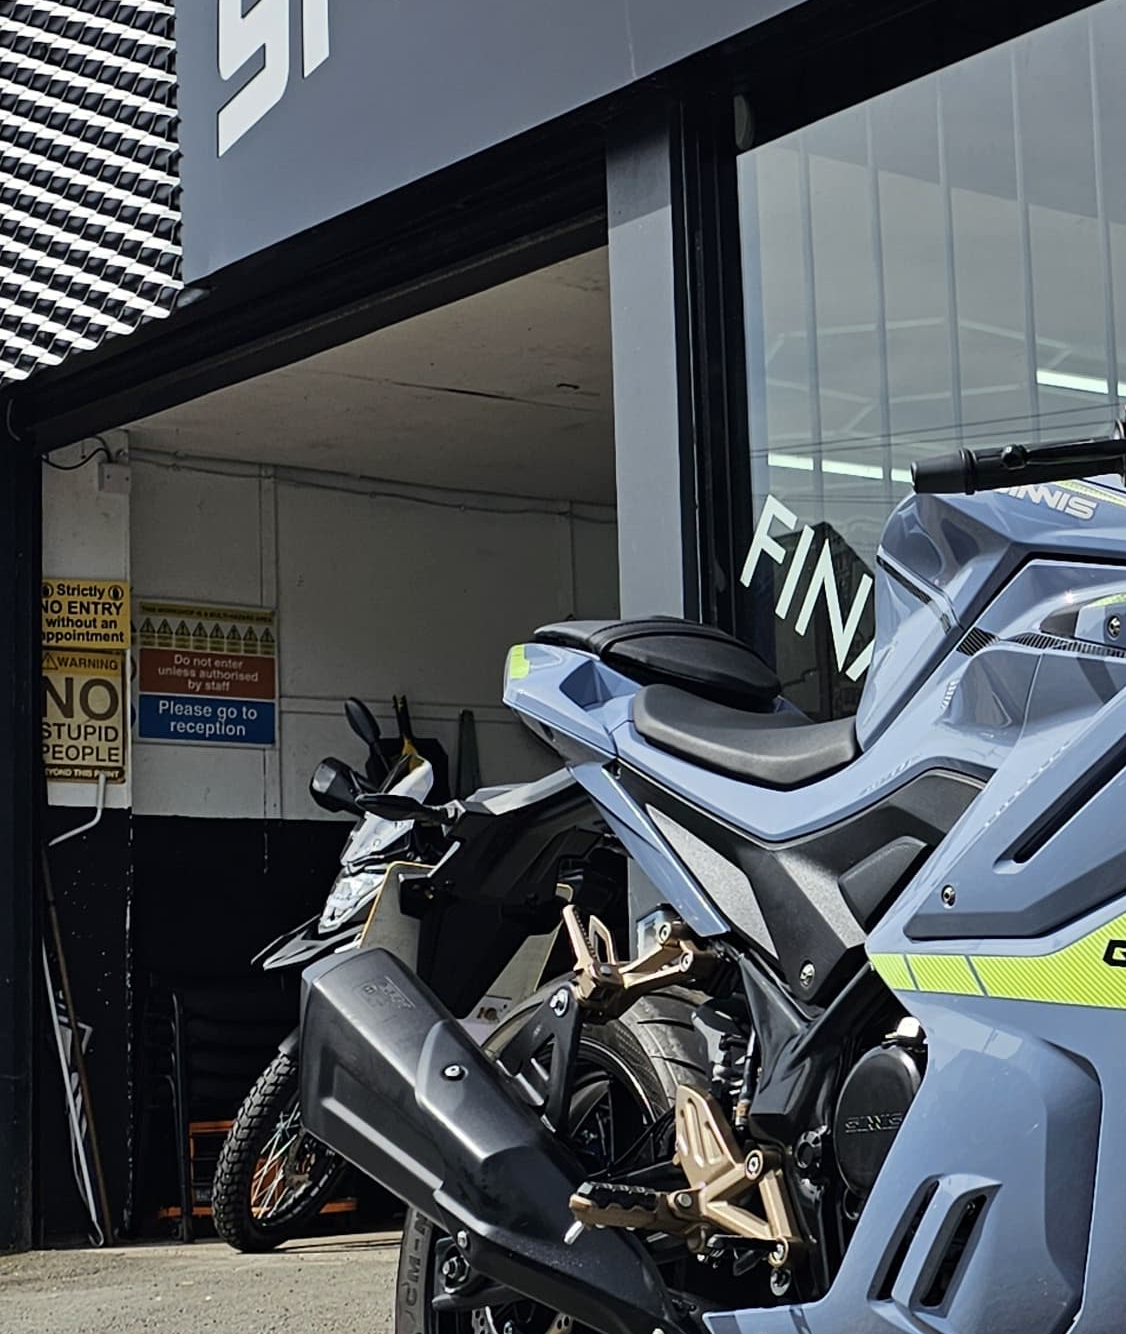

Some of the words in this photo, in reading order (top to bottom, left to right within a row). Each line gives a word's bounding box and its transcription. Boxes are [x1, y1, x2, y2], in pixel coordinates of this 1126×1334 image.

[992, 485, 1097, 520] INNIS
[56, 583, 105, 600] Strictly
[41, 600, 62, 614] NO
[67, 601, 123, 616] ENTRY
[46, 616, 97, 629] without
[101, 620, 118, 629] an
[57, 656, 118, 670] WARNING
[174, 654, 190, 665] Do
[193, 656, 212, 667] not
[214, 659, 243, 669] enter
[158, 666, 197, 679] unless
[199, 668, 259, 682] authorised
[187, 679, 202, 692] by
[205, 681, 230, 691] staff
[42, 676, 119, 721] NO
[158, 700, 212, 717] Please
[217, 707, 238, 723] go
[242, 706, 258, 720] to
[42, 722, 119, 742] STUPID
[170, 720, 246, 738] reception
